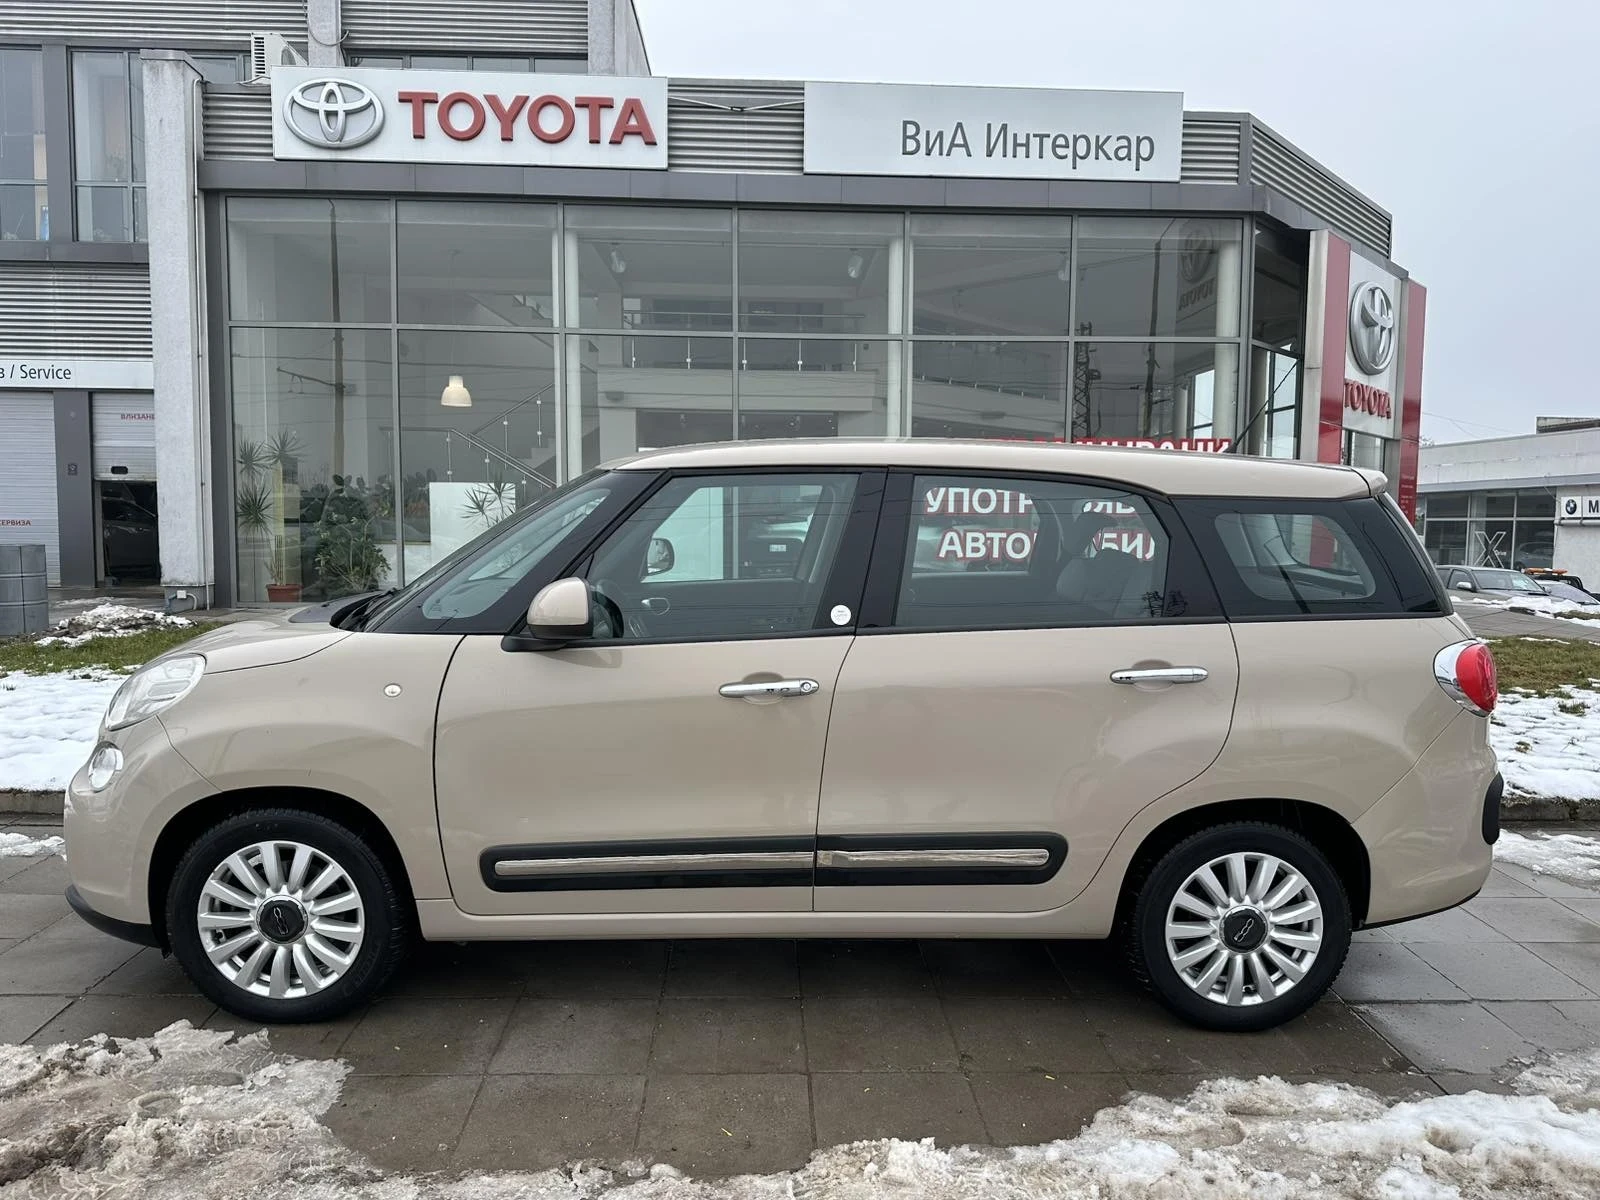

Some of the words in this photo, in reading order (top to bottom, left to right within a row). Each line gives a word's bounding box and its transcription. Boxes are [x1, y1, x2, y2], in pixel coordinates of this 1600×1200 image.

[398, 91, 657, 146] TOYOTA
[902, 120, 972, 157] ВиА
[985, 123, 1155, 171] Интеркар
[20, 364, 71, 379] Service
[1344, 380, 1391, 419] TOYOTA
